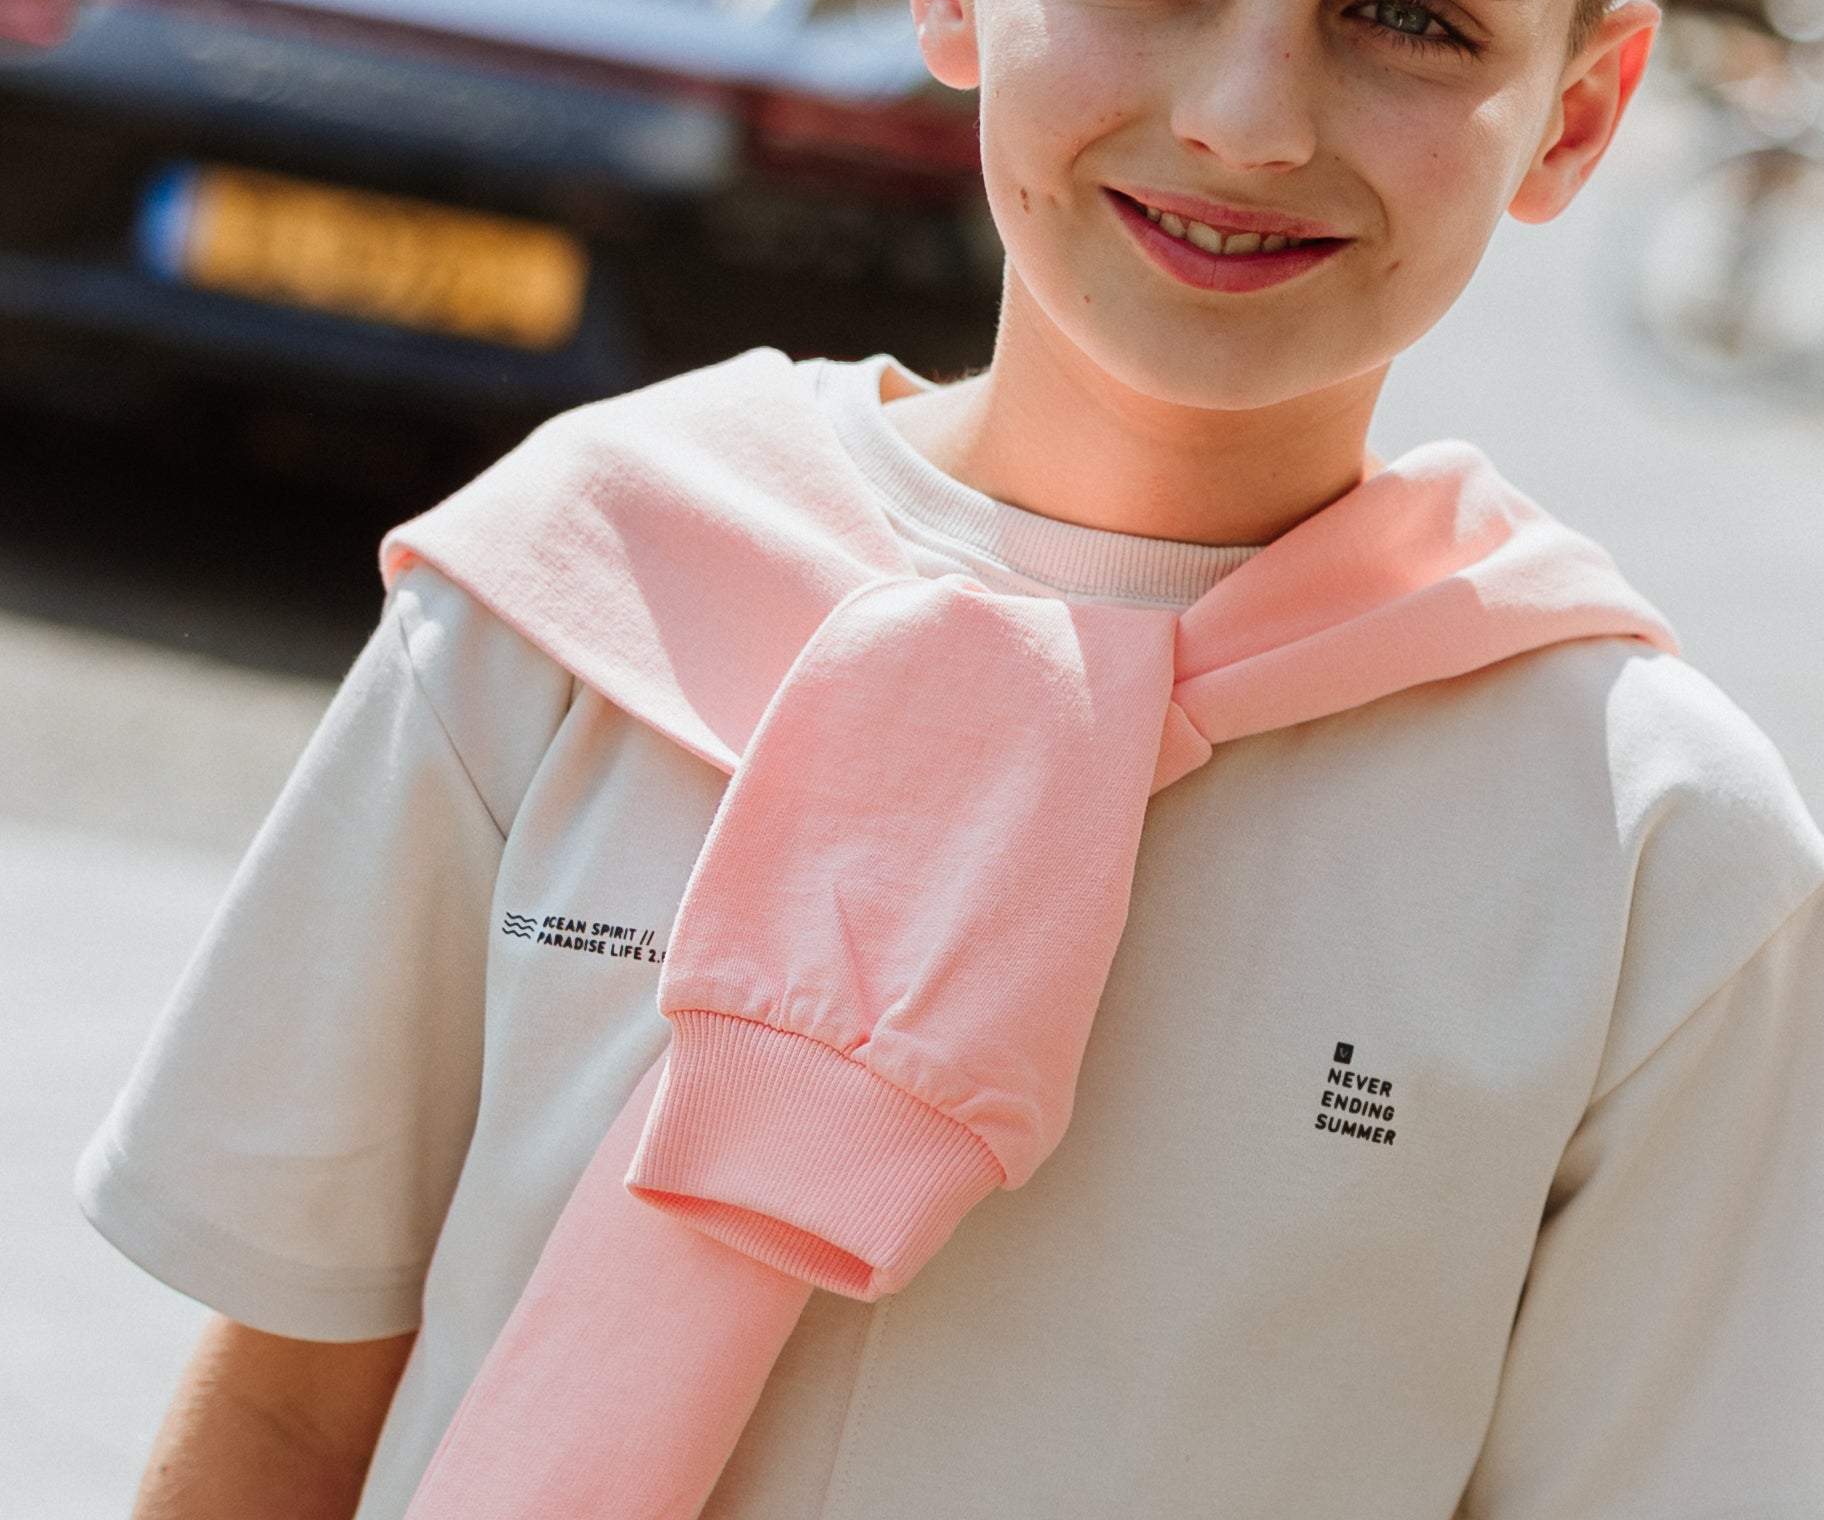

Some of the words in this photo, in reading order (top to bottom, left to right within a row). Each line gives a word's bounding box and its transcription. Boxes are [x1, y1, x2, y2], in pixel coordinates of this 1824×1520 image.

[537, 931, 607, 955] PARADISE
[611, 943, 643, 961] LIFE
[591, 923, 637, 942] SPIRIT
[1327, 1067, 1393, 1098] NEVER
[1320, 1090, 1395, 1122] ENDING
[1314, 1113, 1397, 1146] SUMMER
